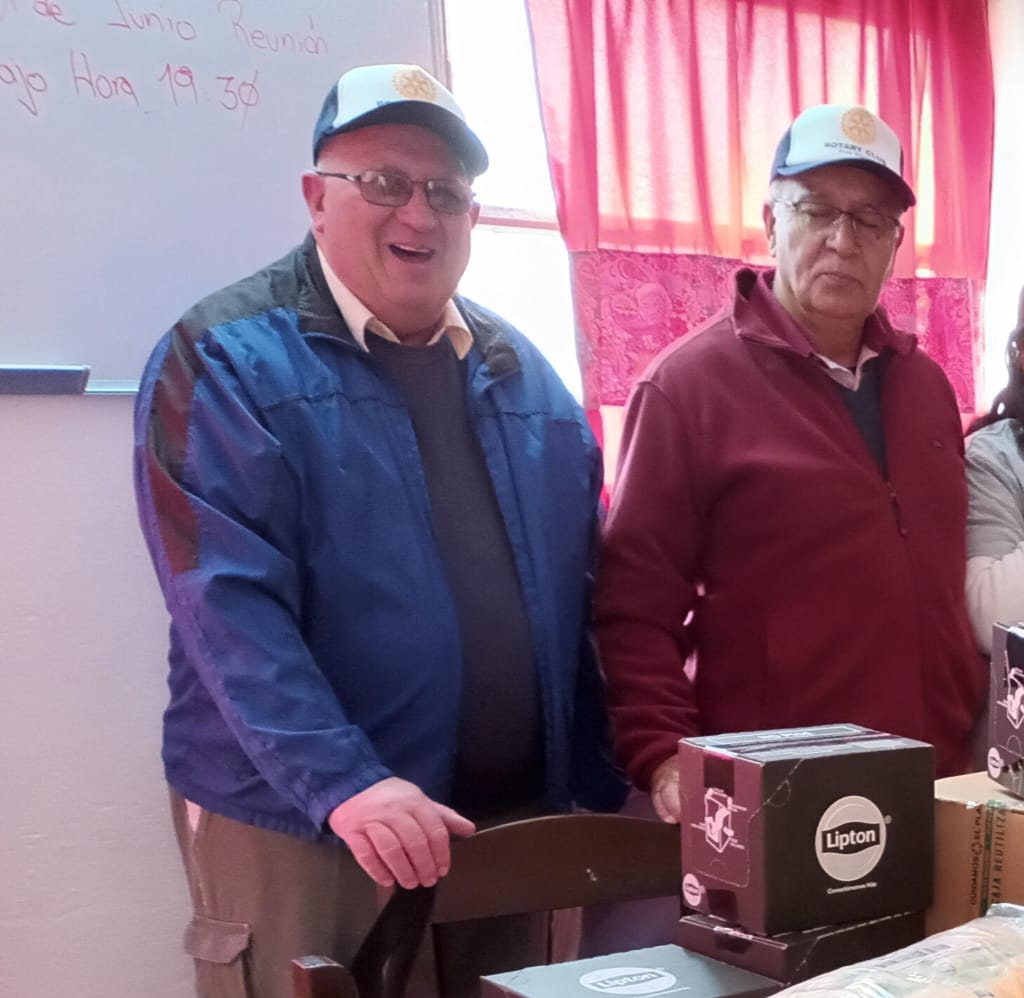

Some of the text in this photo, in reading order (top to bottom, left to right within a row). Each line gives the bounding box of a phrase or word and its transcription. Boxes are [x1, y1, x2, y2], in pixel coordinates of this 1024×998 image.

[107, 0, 196, 41] Junio
[217, 0, 329, 55] Reunión
[69, 48, 139, 107] Hora
[824, 142, 862, 153] ROTARY
[826, 828, 876, 850] Lipton
[597, 973, 658, 988] Lipton
